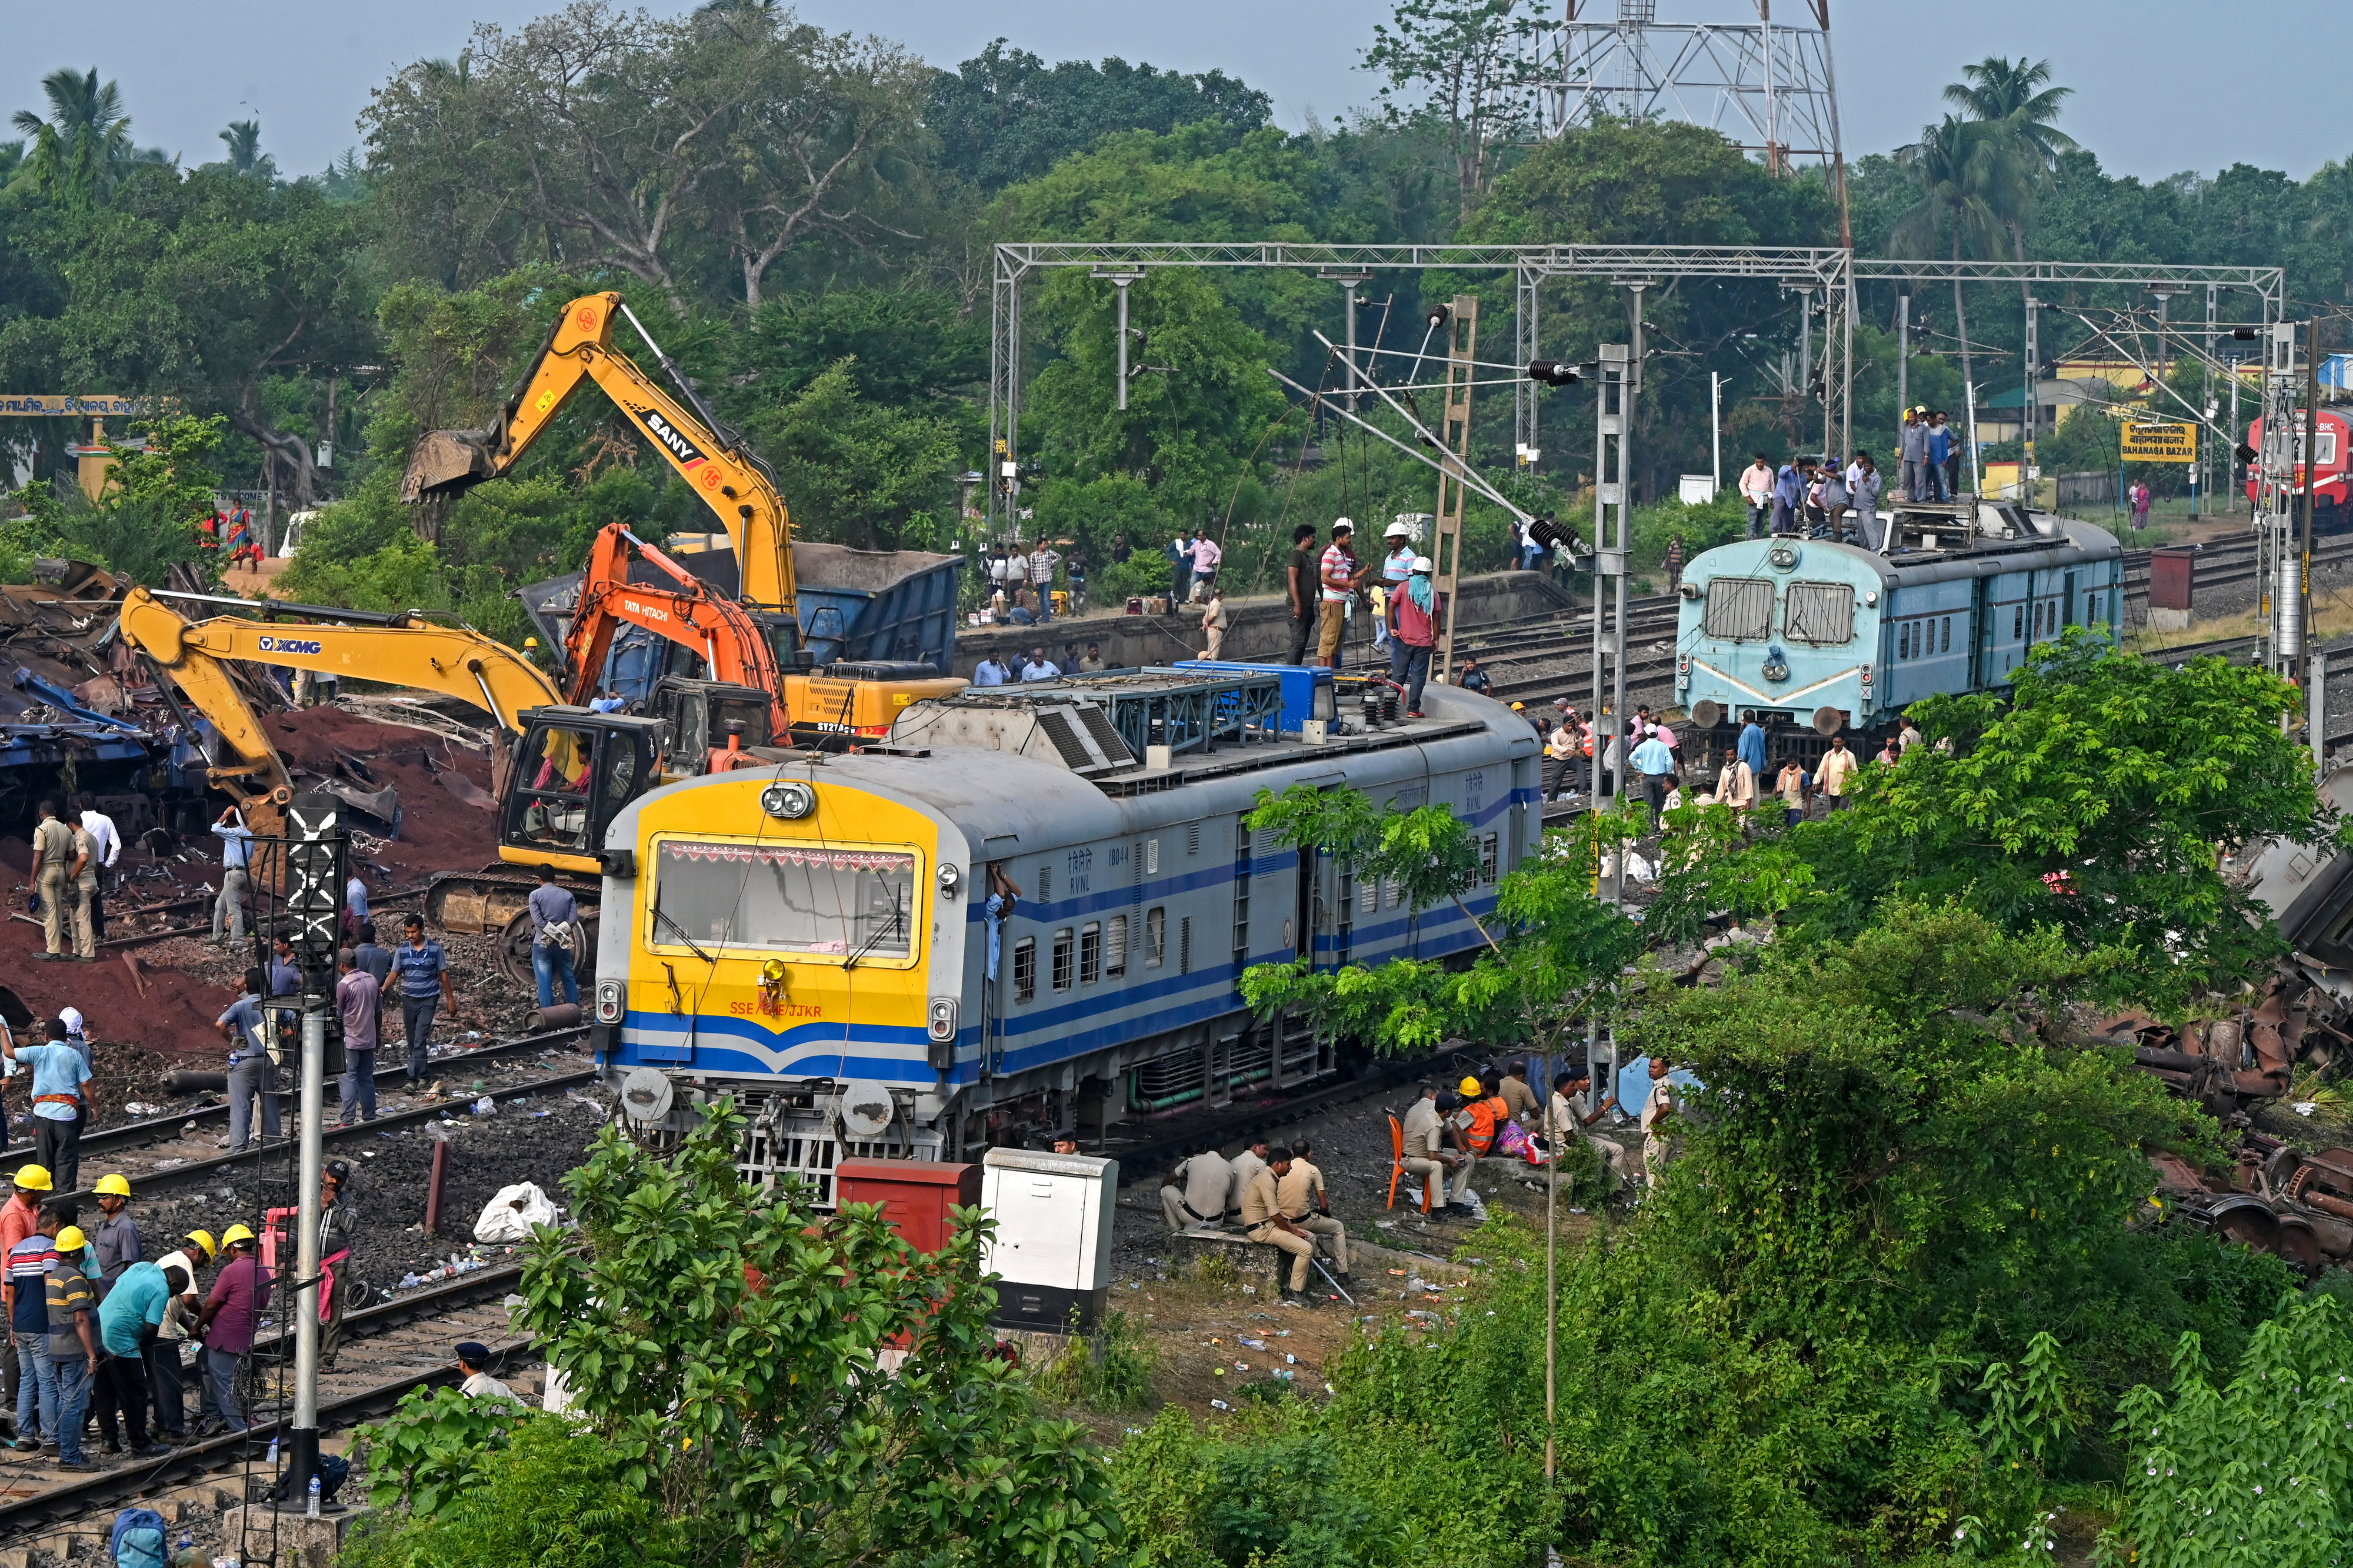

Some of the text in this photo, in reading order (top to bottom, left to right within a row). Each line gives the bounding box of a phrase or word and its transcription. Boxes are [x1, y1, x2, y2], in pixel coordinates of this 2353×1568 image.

[647, 413, 694, 459] SANY
[2122, 446, 2193, 456] BAHANAGA BAZAR
[704, 470, 719, 486] 15
[625, 600, 668, 622] TATA HITACHI
[274, 639, 321, 654] XCMG
[1467, 795, 1481, 813] RVNL
[1109, 846, 1129, 867] 18044
[1070, 874, 1089, 896] RVNL
